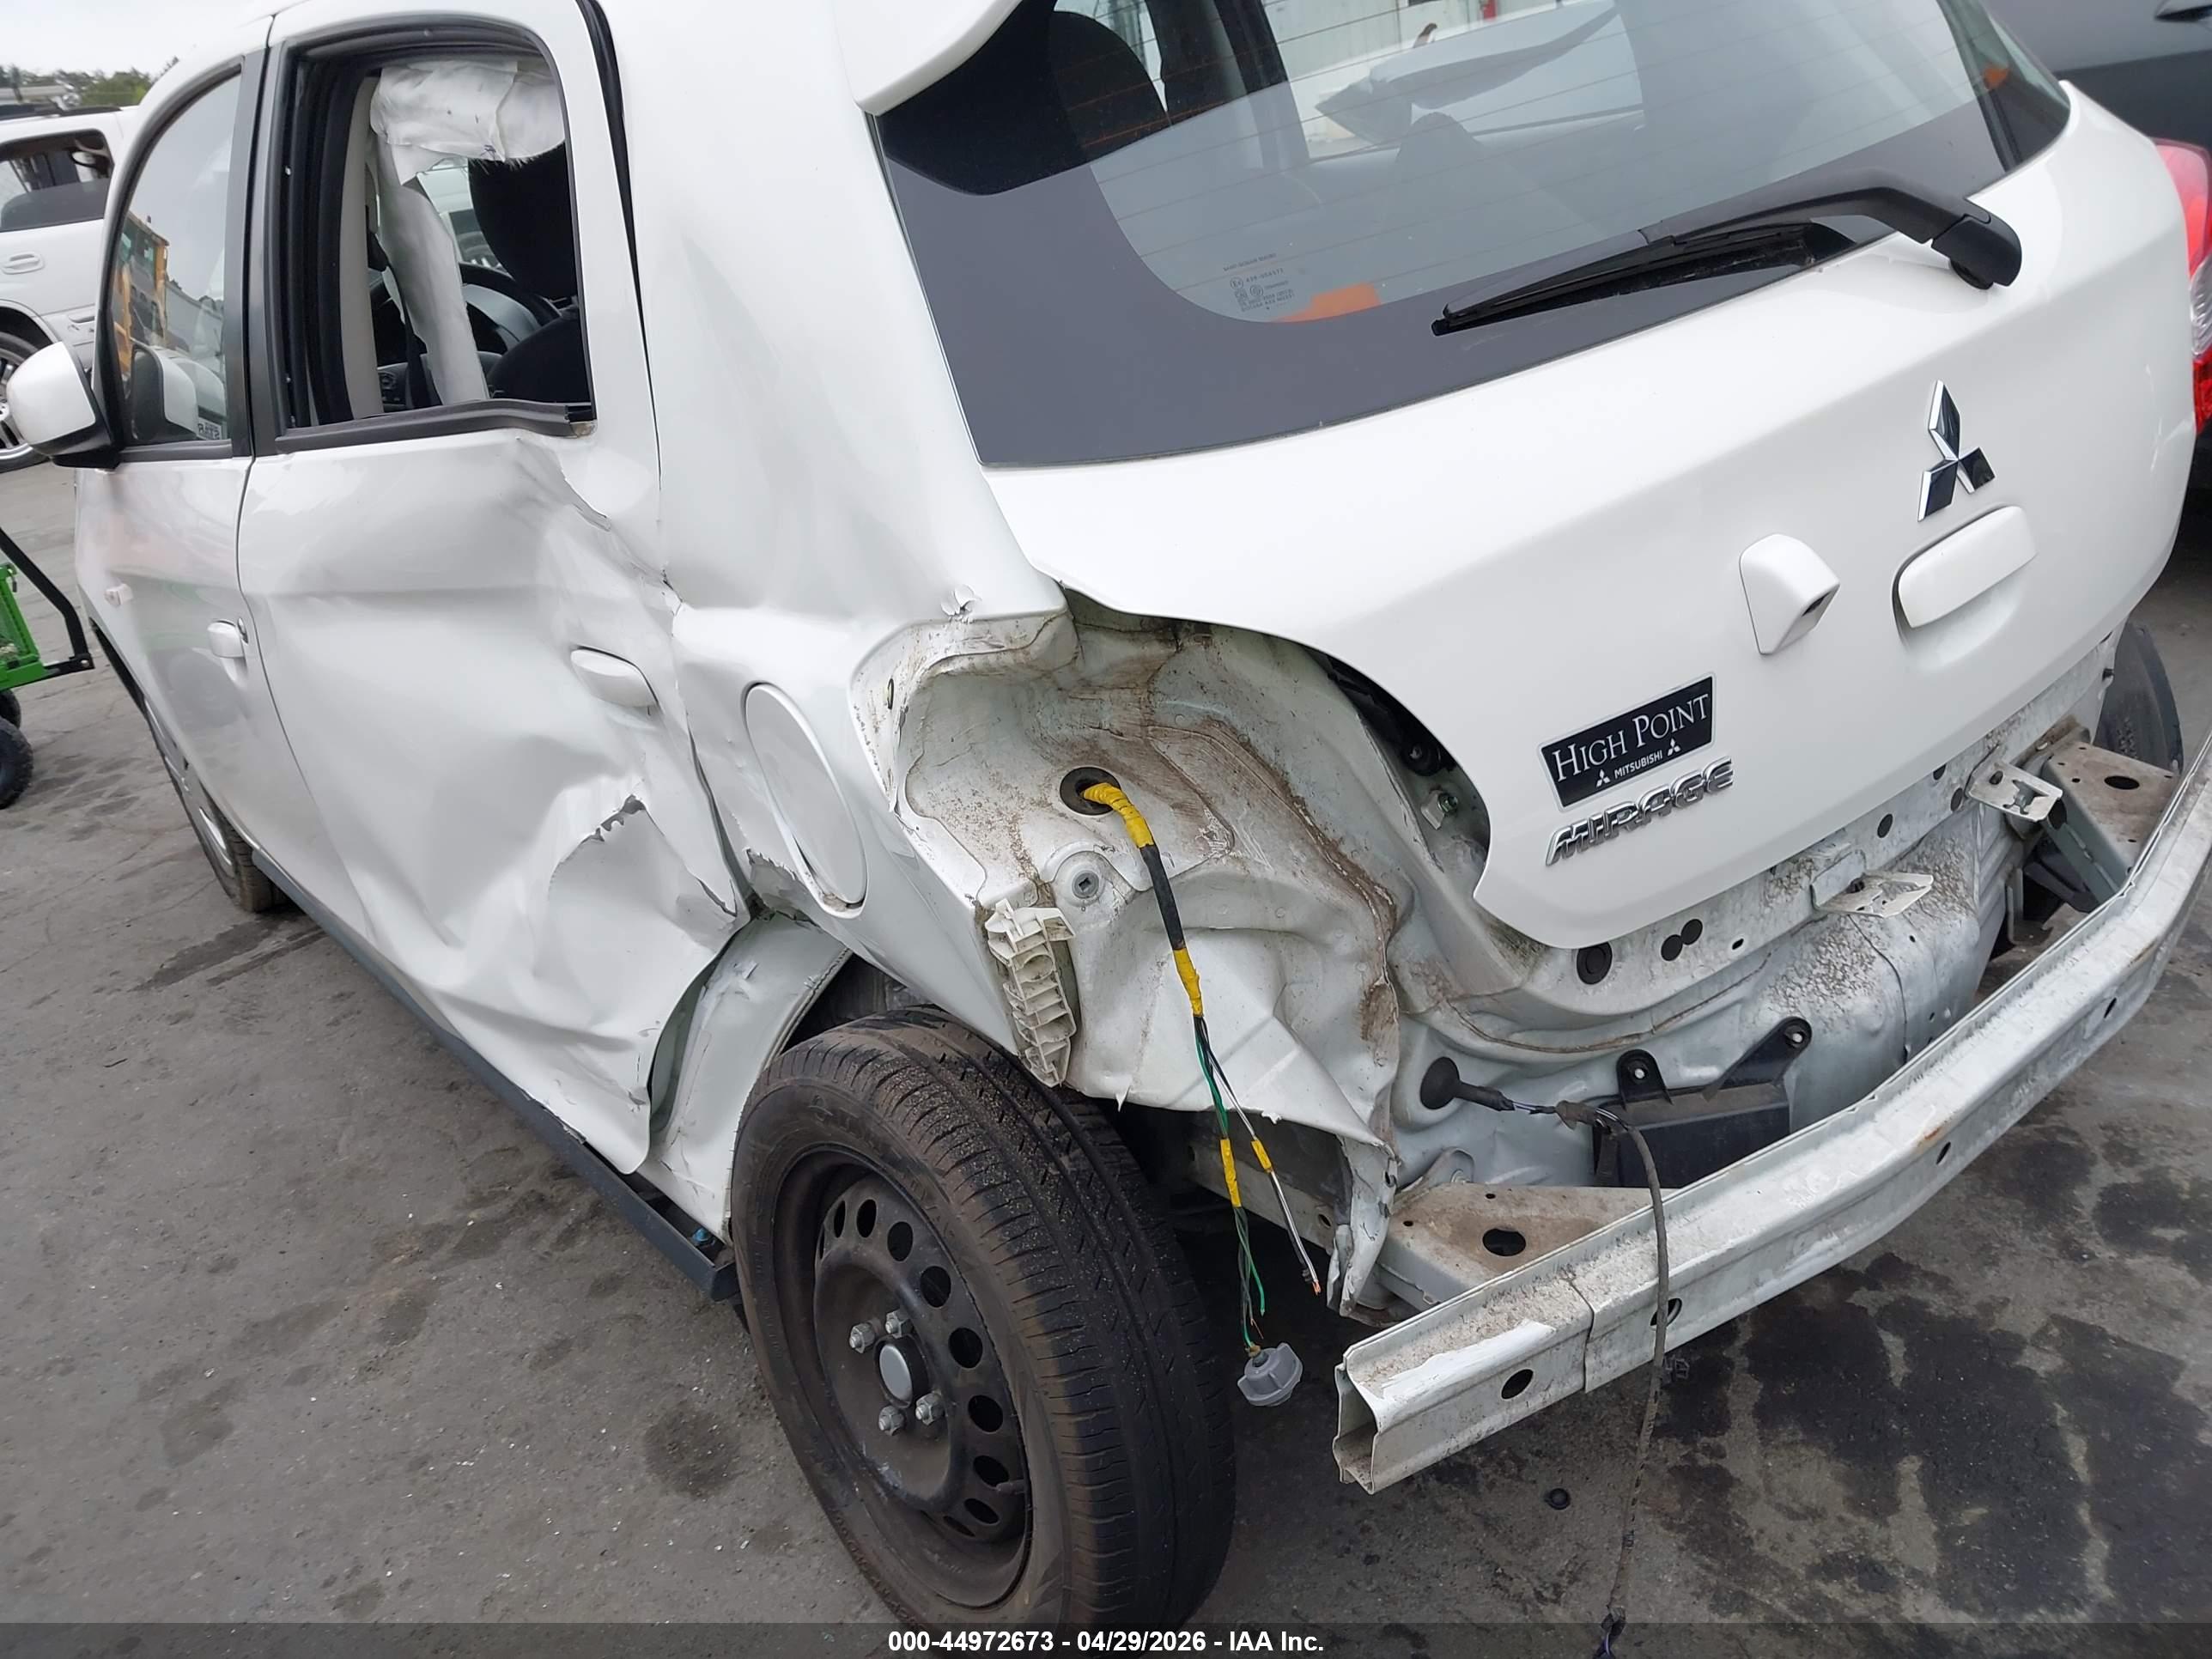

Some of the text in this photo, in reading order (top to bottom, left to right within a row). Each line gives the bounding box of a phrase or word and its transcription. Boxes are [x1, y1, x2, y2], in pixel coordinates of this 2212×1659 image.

[1552, 693, 1709, 782] HIGH POINT
[1613, 750, 1663, 779] MITSUBISHI
[1545, 755, 1734, 867] MIRAGE
